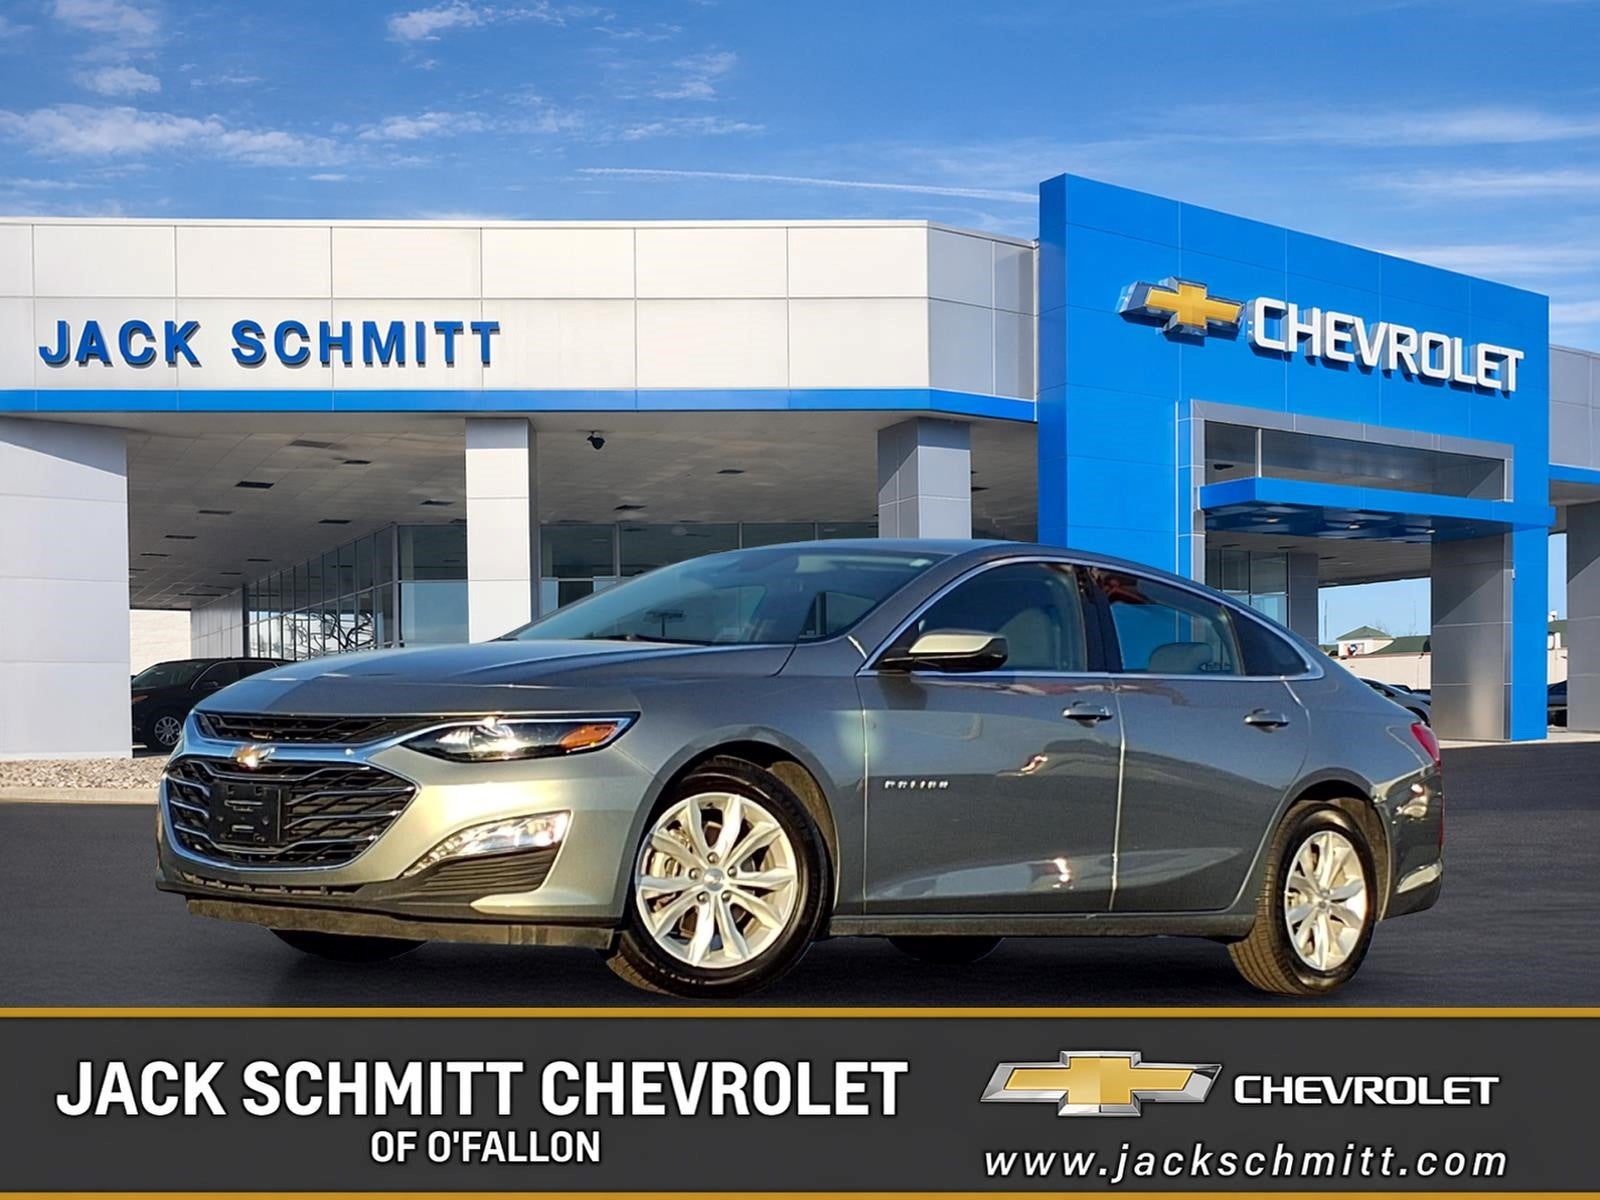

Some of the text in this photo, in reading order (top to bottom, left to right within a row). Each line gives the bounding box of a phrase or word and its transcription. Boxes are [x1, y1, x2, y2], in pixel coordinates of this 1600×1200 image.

[39, 320, 499, 366] JACK SCHMITT
[1247, 297, 1524, 391] CHEVROLET
